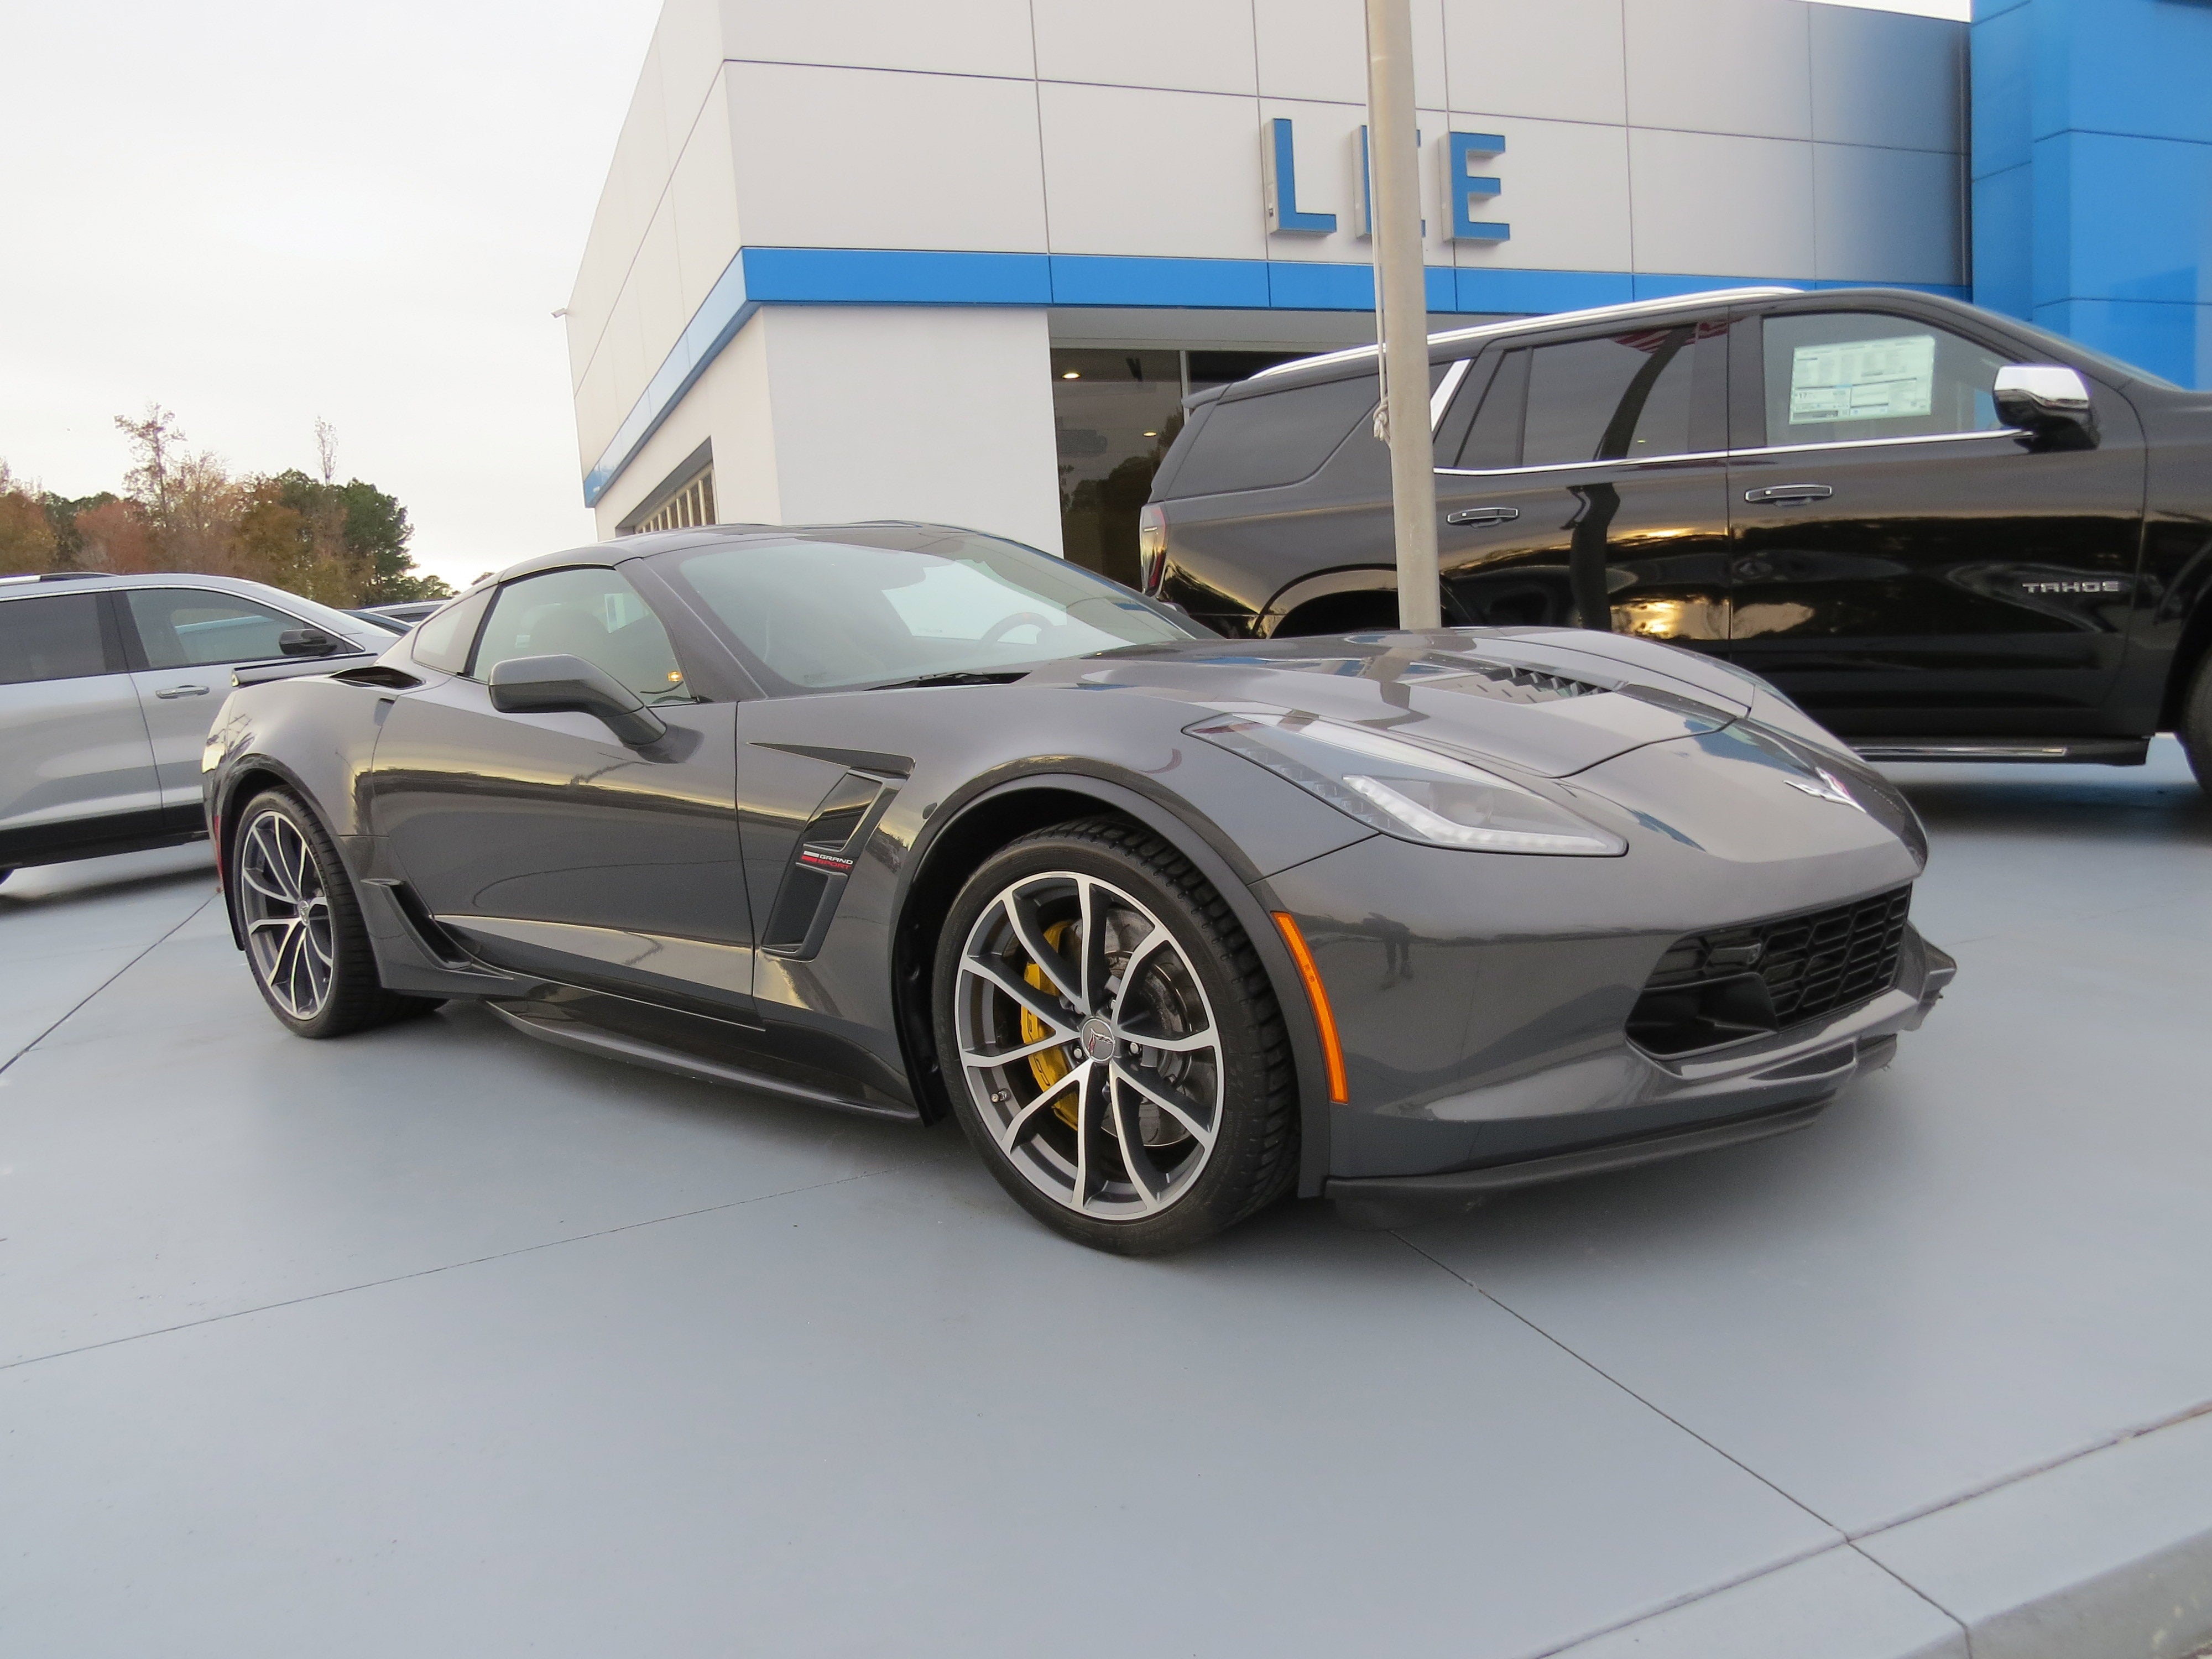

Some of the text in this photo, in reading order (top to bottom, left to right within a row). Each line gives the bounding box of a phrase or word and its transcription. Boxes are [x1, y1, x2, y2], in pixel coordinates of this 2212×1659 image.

[1266, 118, 1510, 242] LE
[2022, 581, 2119, 593] TAHOE
[816, 858, 852, 870] SPORT
[819, 853, 854, 865] GRAND
